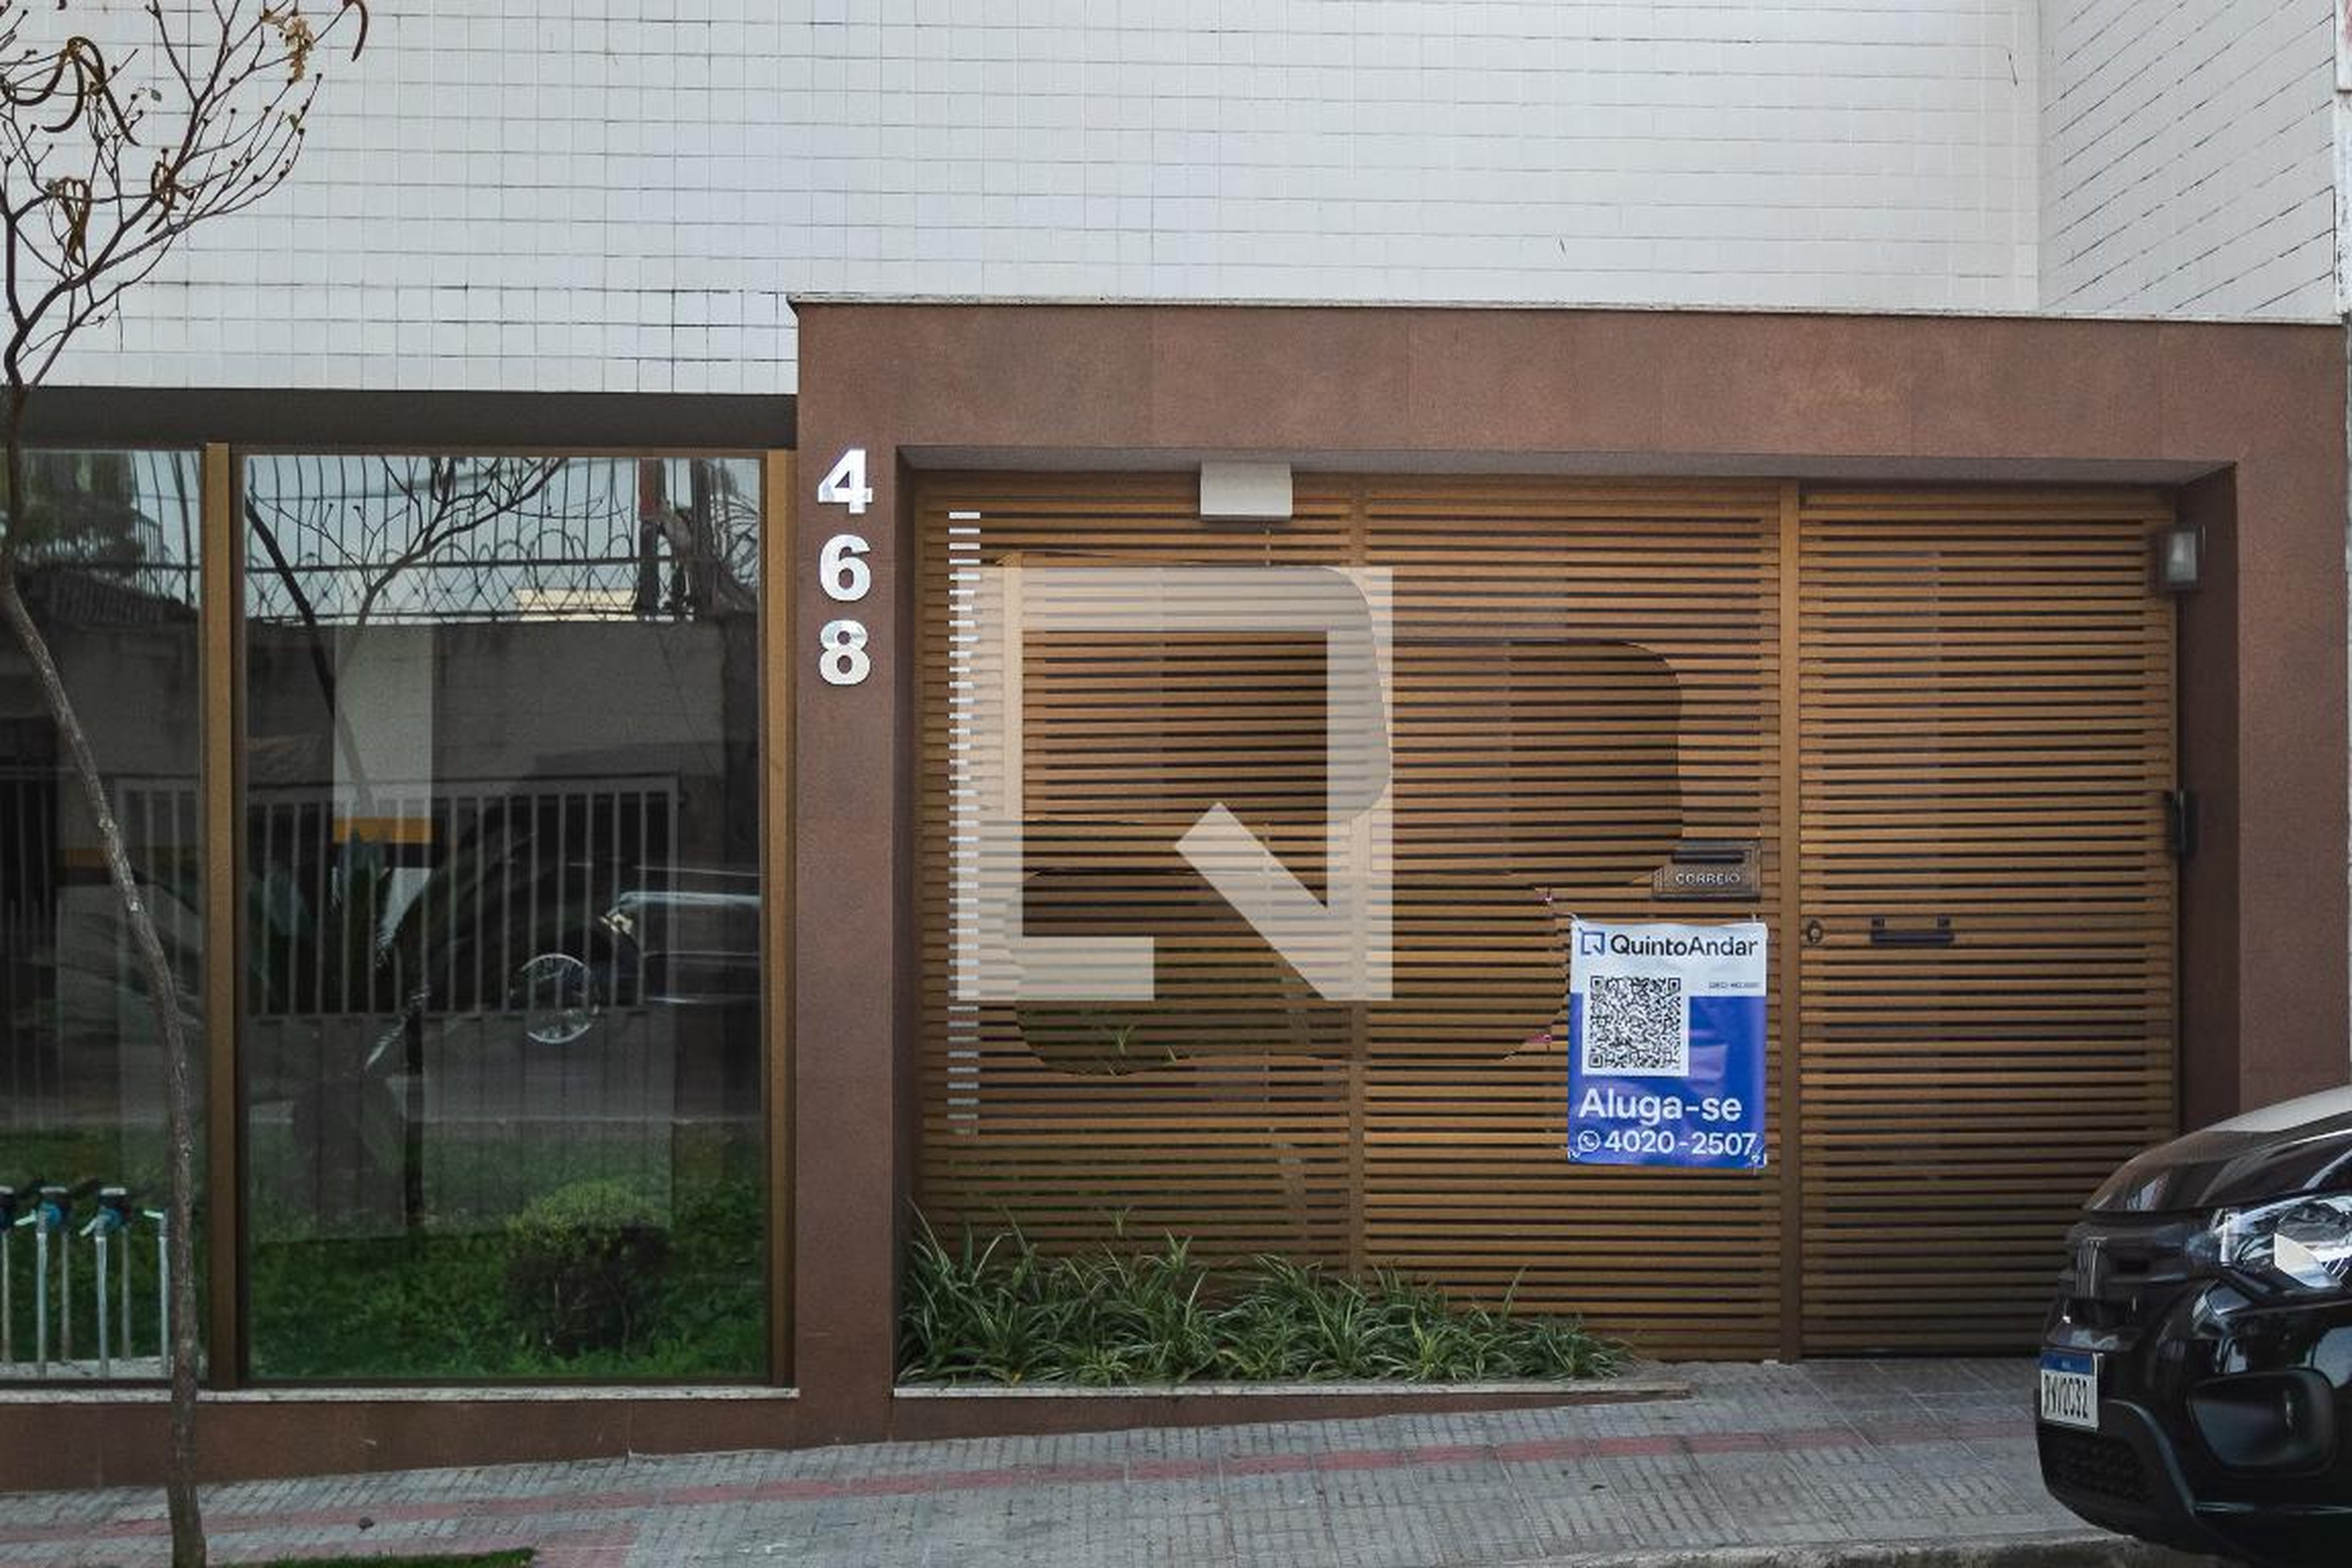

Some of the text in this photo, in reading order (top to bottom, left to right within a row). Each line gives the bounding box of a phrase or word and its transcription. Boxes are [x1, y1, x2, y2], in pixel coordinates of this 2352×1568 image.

[818, 448, 873, 685] 468
[1675, 873, 1740, 885] CORREIO
[1610, 934, 1758, 956] QuintoAndar
[1578, 1088, 1742, 1126] Aluga-se
[1604, 1131, 1757, 1156] 4020-2507
